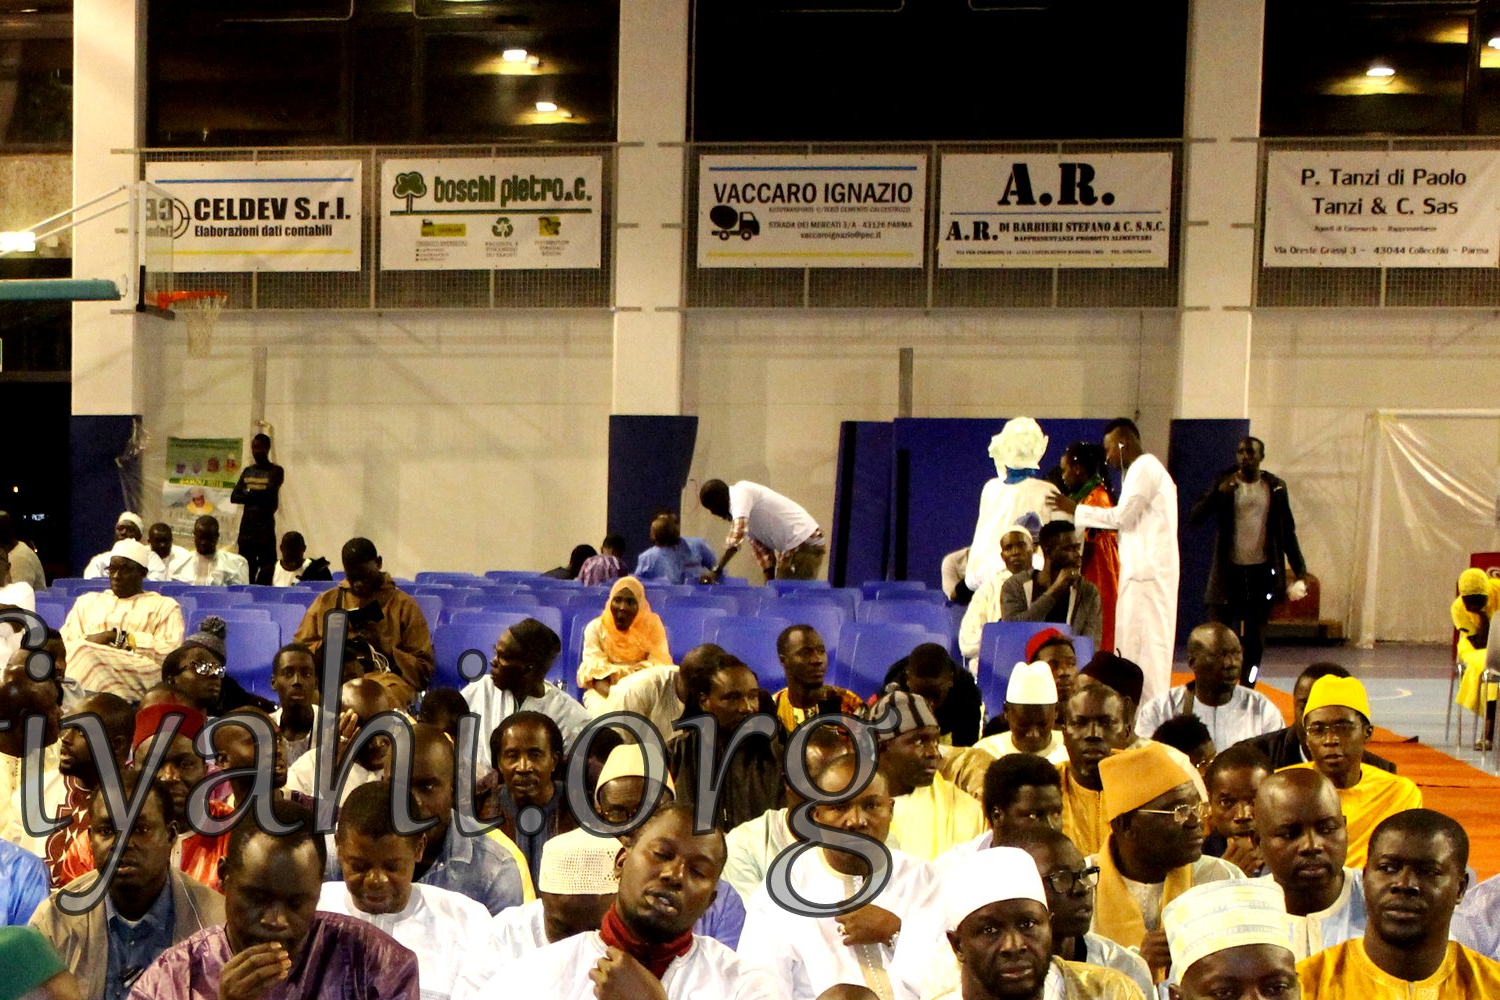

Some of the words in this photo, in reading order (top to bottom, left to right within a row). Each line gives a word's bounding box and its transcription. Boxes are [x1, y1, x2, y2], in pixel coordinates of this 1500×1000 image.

[997, 162, 1116, 206] A.R.
[1301, 168, 1320, 186] P.
[1329, 168, 1380, 186] Tanzi
[1387, 168, 1404, 186] di
[1413, 168, 1467, 186] Paolo
[434, 175, 496, 203] boschi
[713, 183, 817, 204] VACCARO
[824, 182, 913, 204] IGNAZIO
[194, 197, 288, 221] CELDEV
[294, 197, 351, 221] S.r.l.
[1312, 197, 1363, 215] Tanzi
[1370, 198, 1387, 215] &
[1396, 198, 1414, 215] C.
[1423, 198, 1458, 215] Sas
[194, 224, 259, 238] Elaborazioni
[261, 225, 282, 237] dati
[284, 224, 332, 237] contabili
[768, 221, 795, 229] STRADA
[810, 221, 841, 229] MERCATI
[887, 221, 913, 229] PARMA
[945, 220, 998, 241] A.R.
[999, 221, 1010, 232] DI
[1013, 221, 1064, 232] BARBIERI
[1066, 221, 1111, 233] STEFANO
[1274, 246, 1287, 254] Via
[1289, 246, 1318, 254] Oreste
[1350, 246, 1357, 254] 3
[1373, 246, 1406, 254] 43044
[1408, 246, 1449, 254] Collecchio
[1461, 246, 1490, 254] Parma
